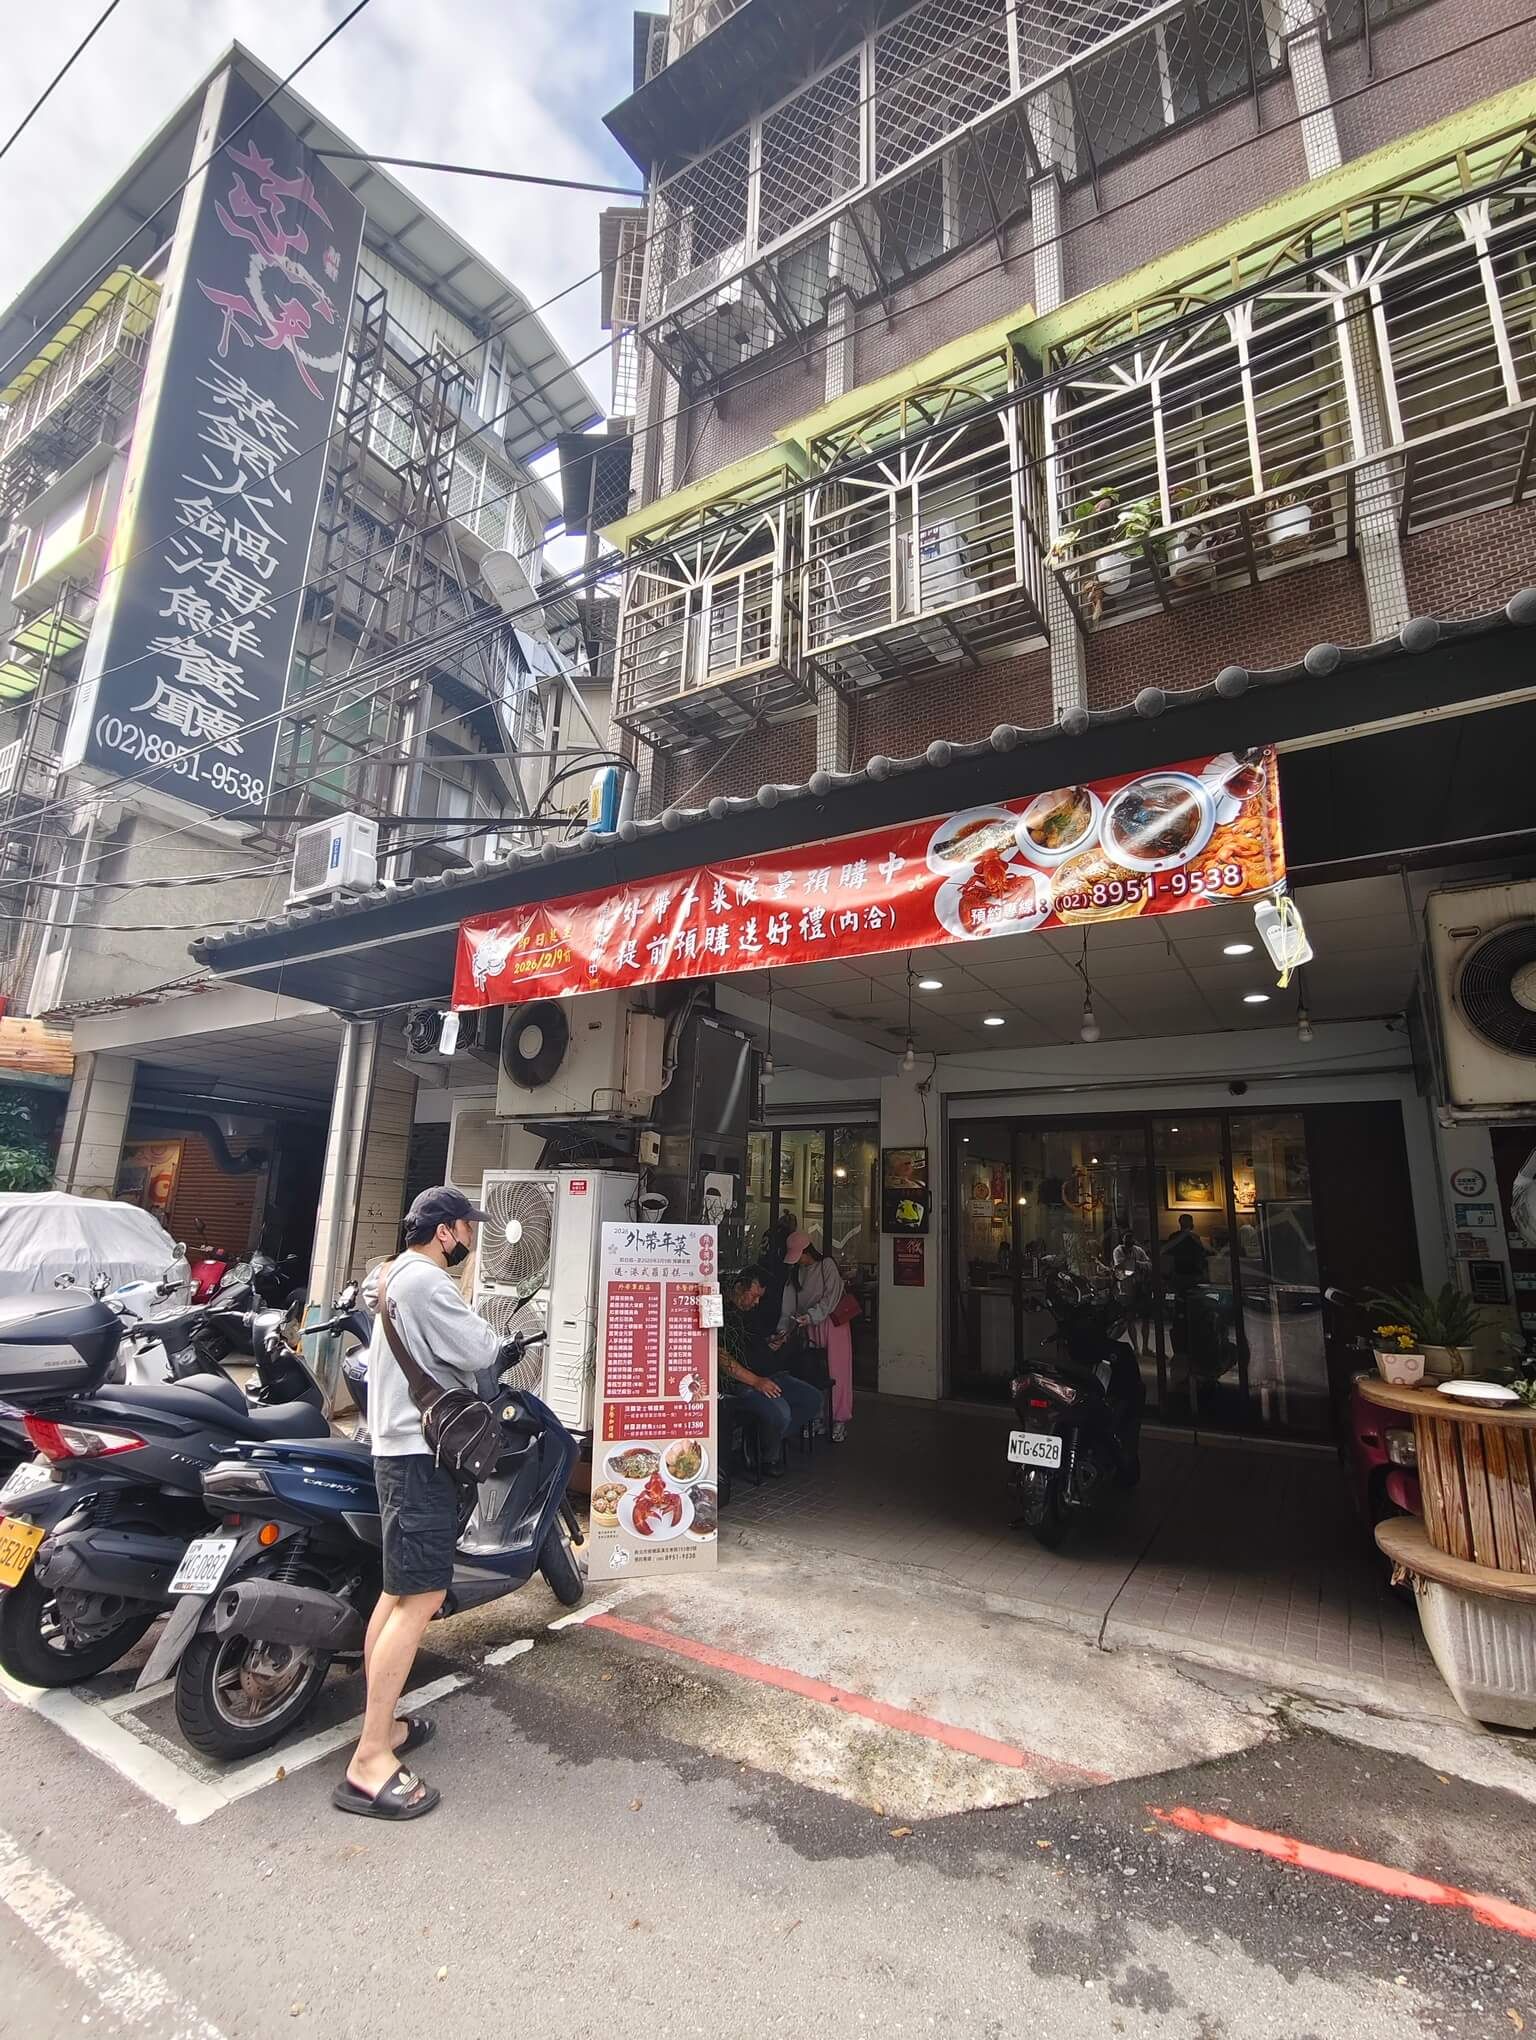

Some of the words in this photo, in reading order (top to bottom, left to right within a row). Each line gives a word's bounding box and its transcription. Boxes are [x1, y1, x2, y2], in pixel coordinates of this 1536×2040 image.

[130, 357, 302, 758] 蒸氣火鍋海鮮餐廳
[95, 714, 265, 807] (02)8951-9538
[624, 1229, 691, 1256] 外帶年菜
[1010, 1439, 1060, 1460] NTG-6528
